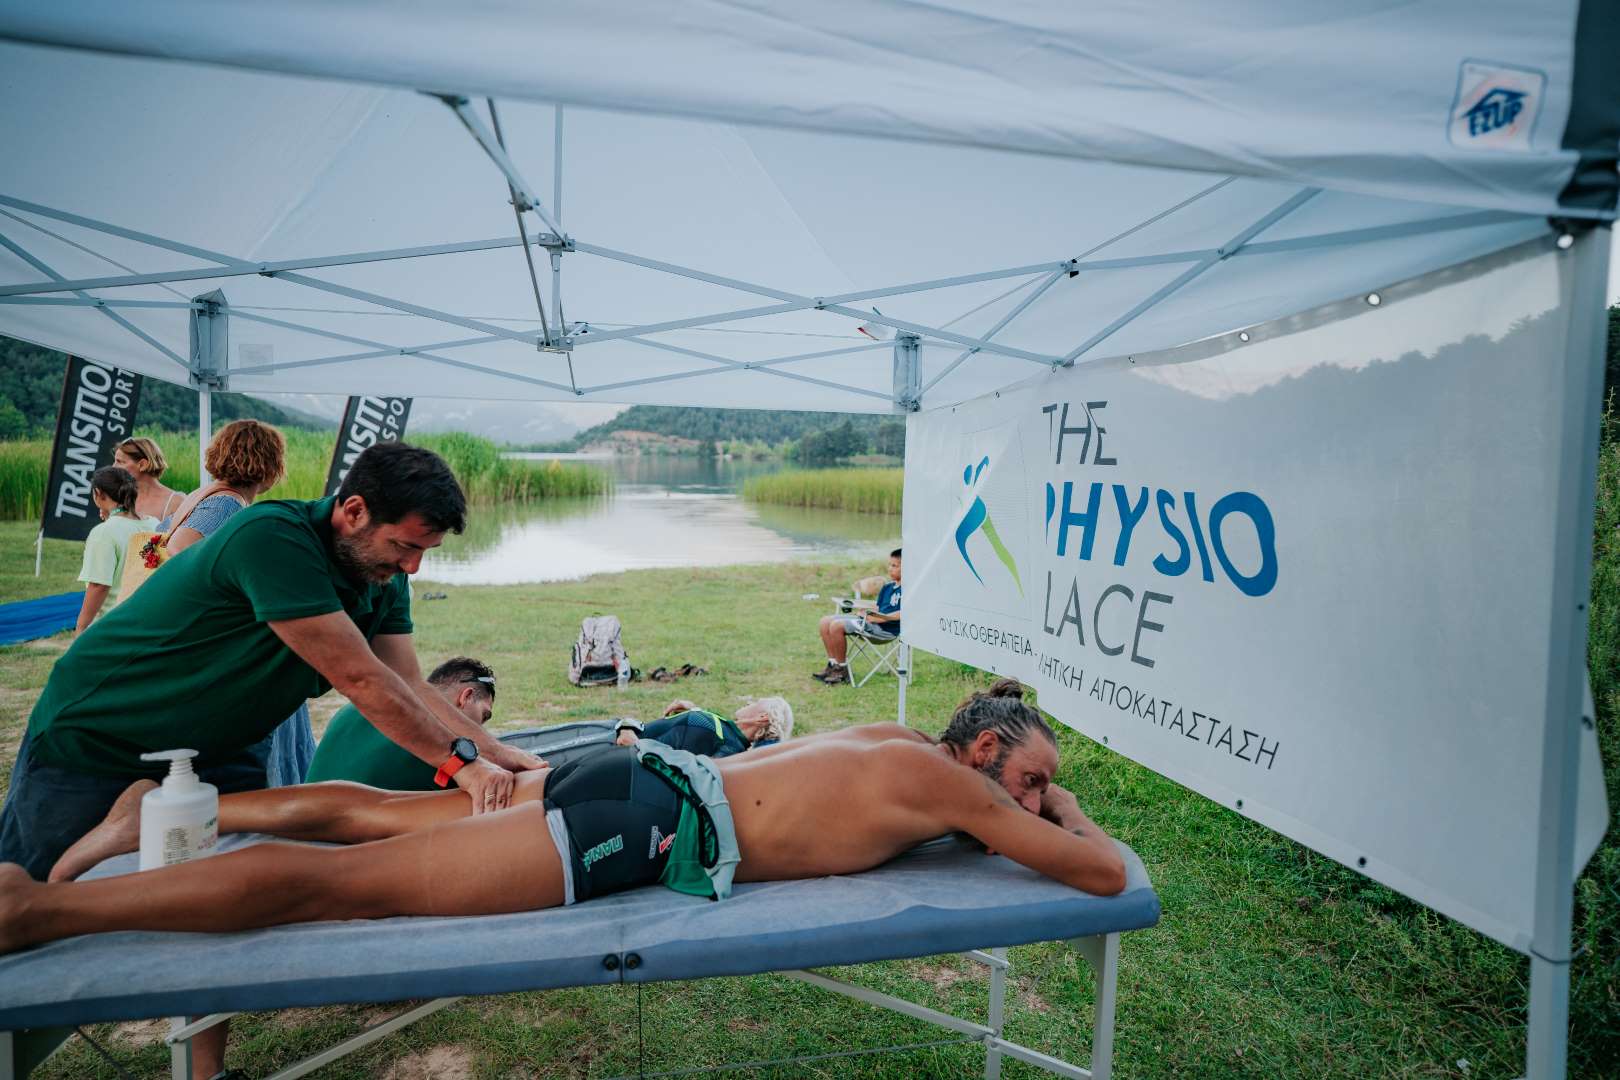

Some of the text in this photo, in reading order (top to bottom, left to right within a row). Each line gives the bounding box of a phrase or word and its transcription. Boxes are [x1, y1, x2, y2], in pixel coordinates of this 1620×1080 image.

[54, 358, 115, 519] TRANSITIO
[381, 396, 408, 443] SPO
[1042, 401, 1117, 465] THE
[1043, 570, 1174, 668] LACE
[1090, 677, 1280, 770] ΑΠΟΚΑΤΑΣΤΑΣΗ
